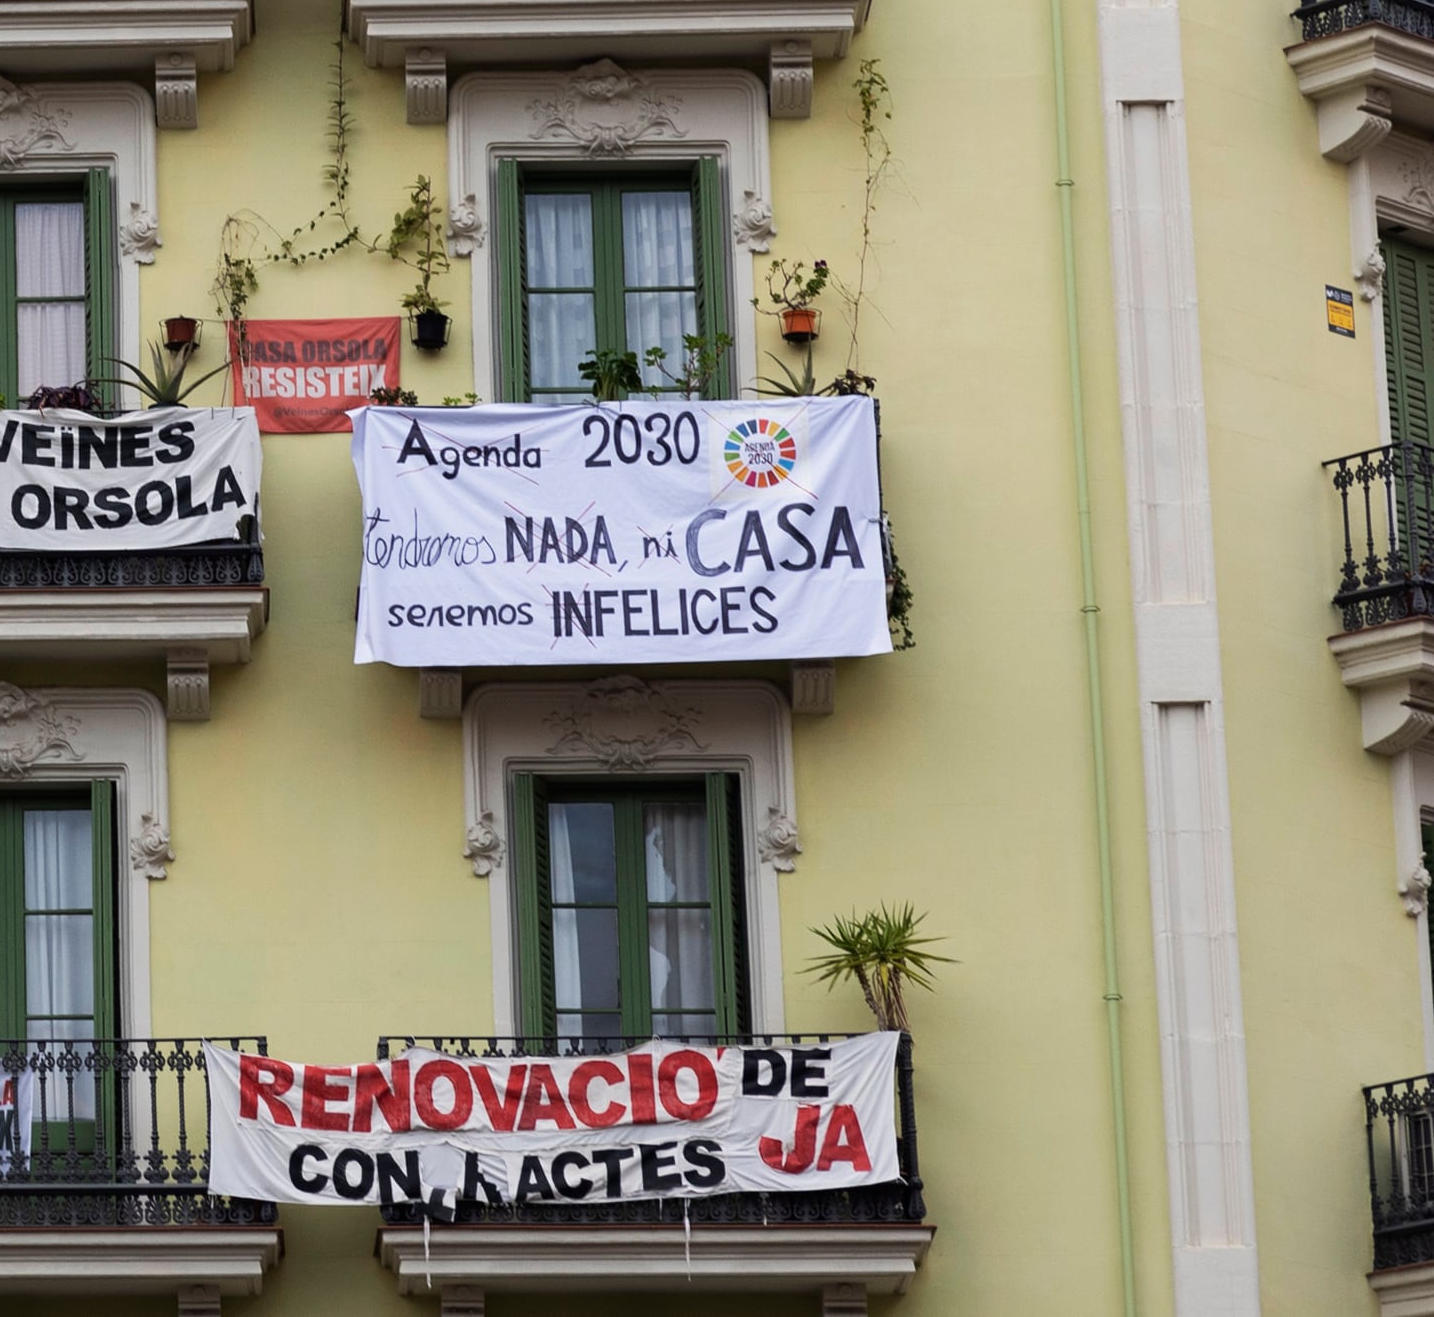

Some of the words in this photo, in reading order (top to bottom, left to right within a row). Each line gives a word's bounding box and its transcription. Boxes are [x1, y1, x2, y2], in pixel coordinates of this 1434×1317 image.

[301, 338, 387, 363] ORSOLA
[243, 364, 386, 398] RESISTEIX
[396, 418, 541, 480] Agenda
[582, 411, 700, 468] 2030
[748, 452, 773, 464] 2030
[11, 465, 246, 531] ORSOLA
[642, 531, 679, 558] ni
[685, 502, 866, 577] CASA
[552, 586, 779, 637] INFELICES
[742, 1048, 832, 1098] DE
[759, 1104, 872, 1174] JA
